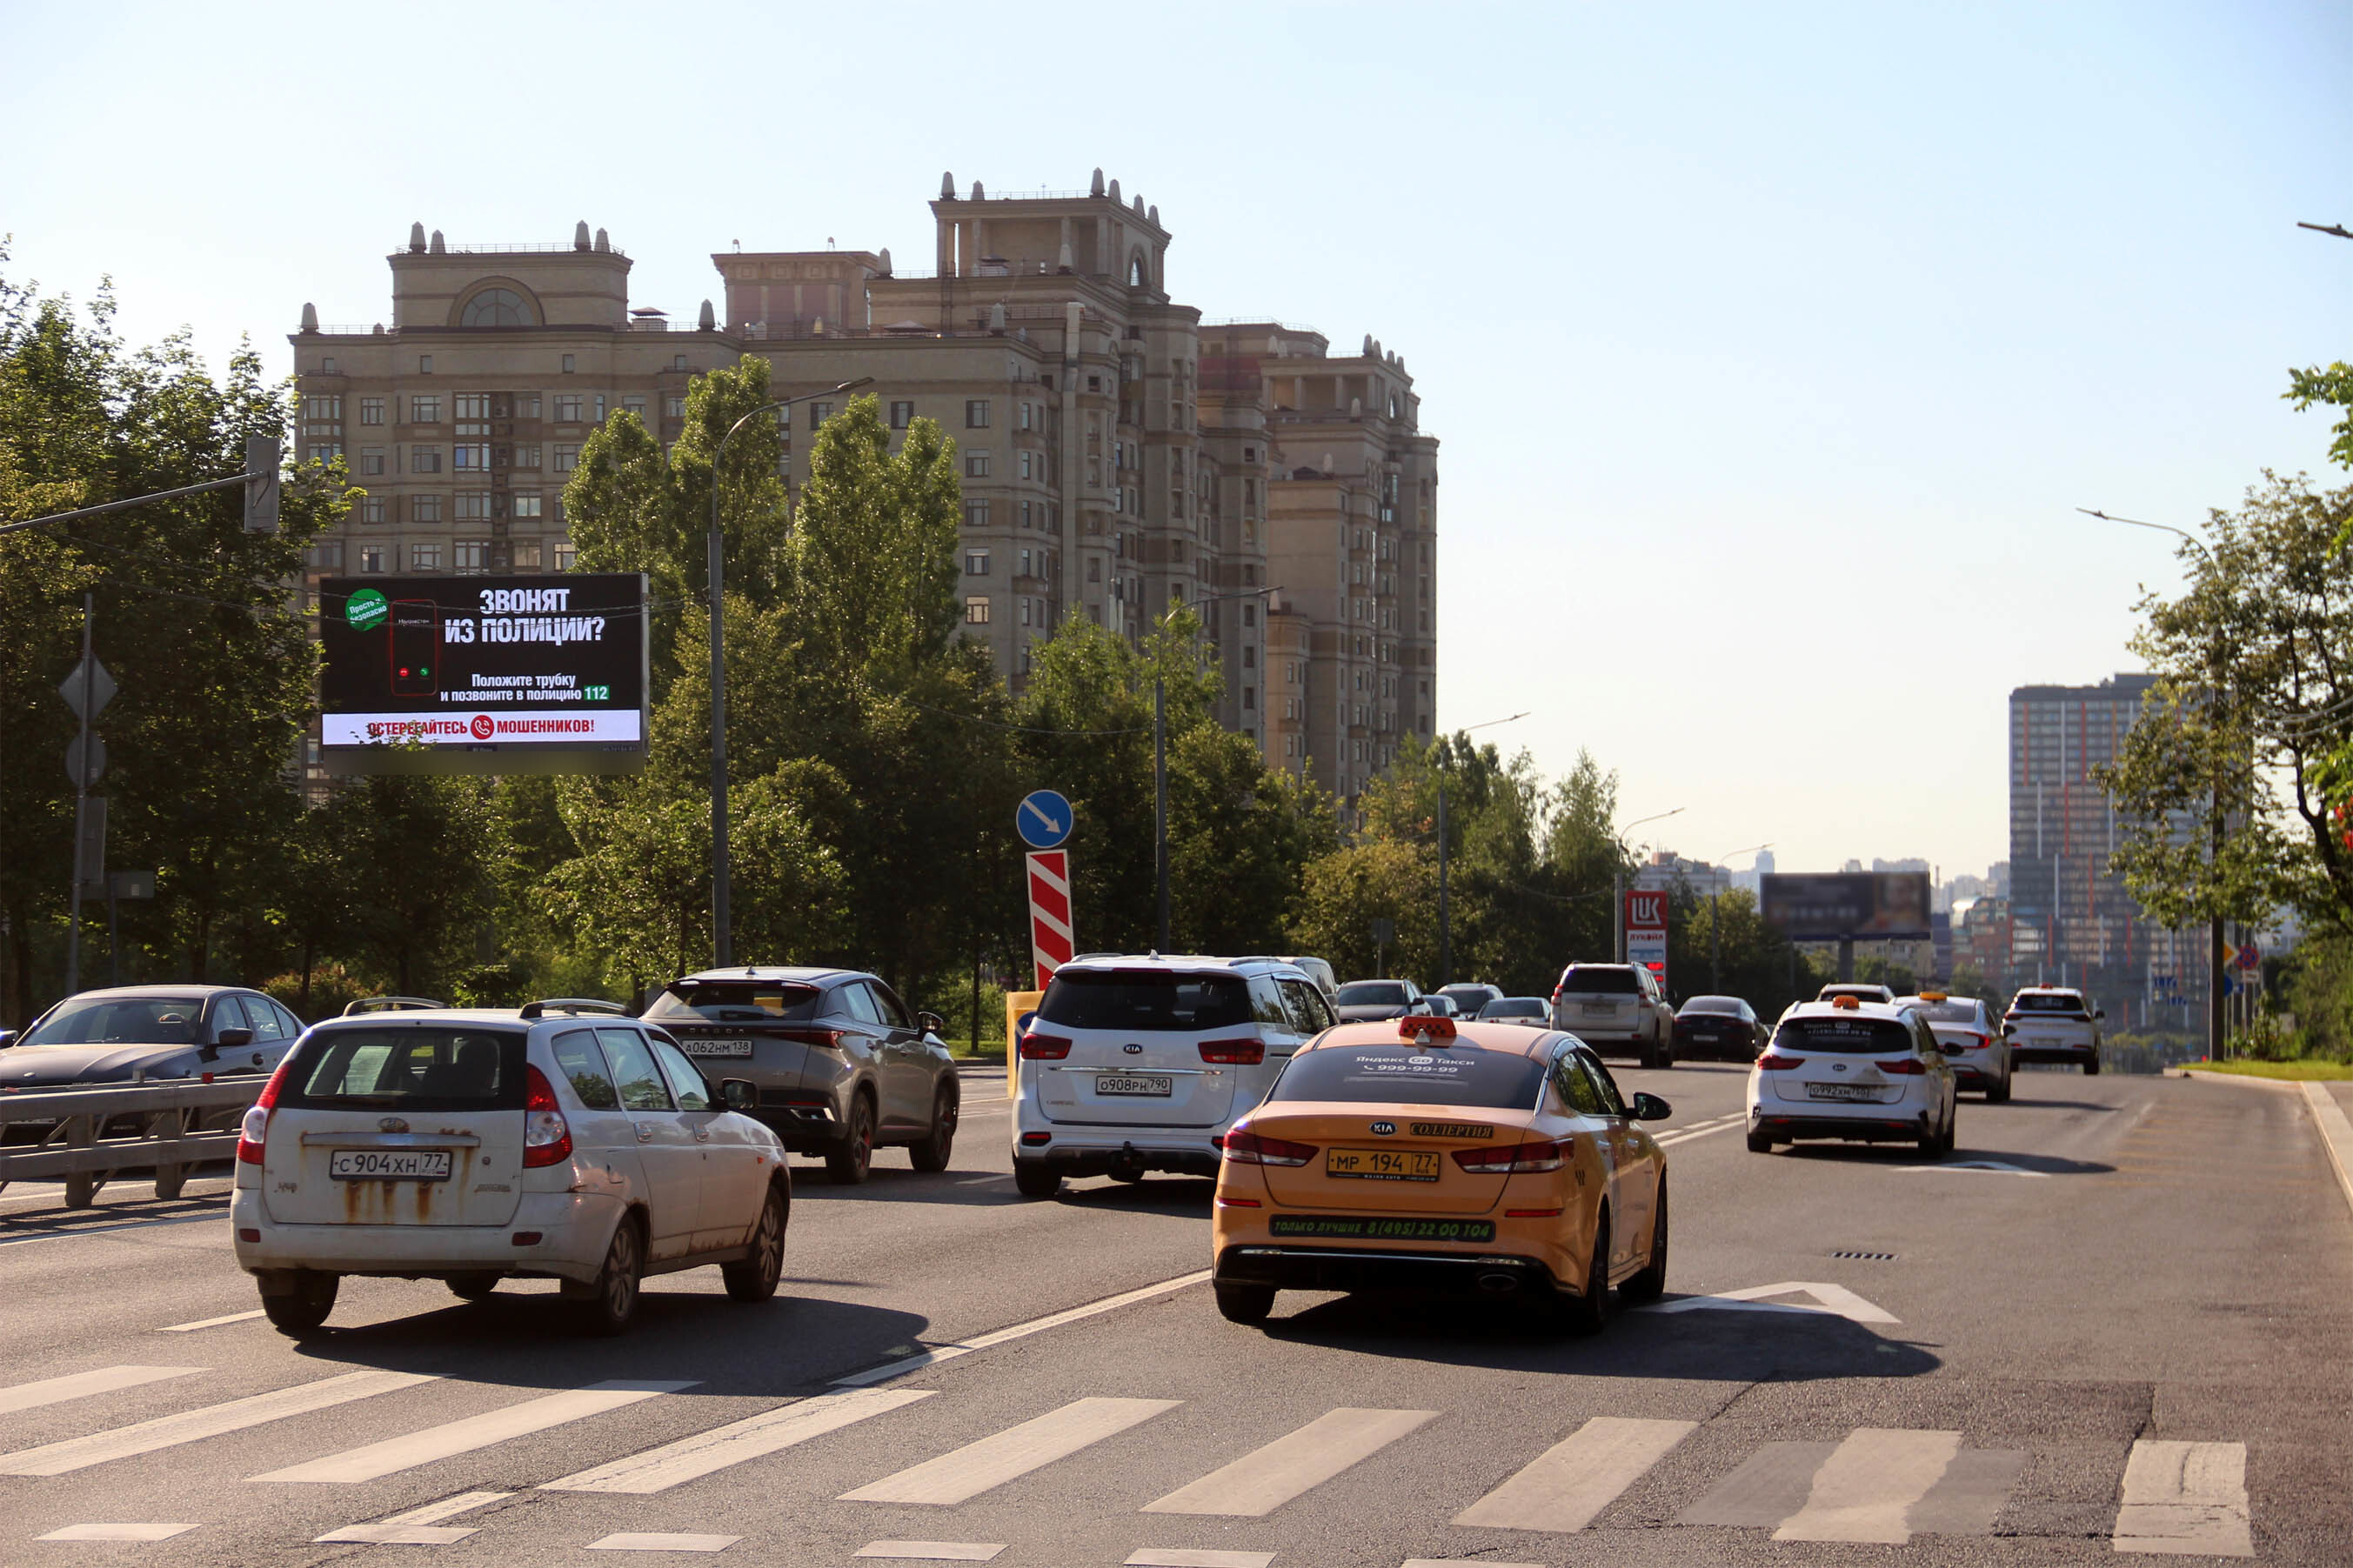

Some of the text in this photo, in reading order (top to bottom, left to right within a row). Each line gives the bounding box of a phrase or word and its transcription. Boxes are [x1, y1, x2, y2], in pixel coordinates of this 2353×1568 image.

[350, 600, 374, 614] Просто
[480, 589, 570, 614] ЗВОНЯТ
[445, 617, 605, 646] ИЗ ПОЛИЦИИ?
[471, 673, 576, 689] Положите трубку
[440, 686, 608, 702] и позвоните в полицию 112
[497, 719, 595, 733] МОШЕННИКОВ!
[1100, 1079, 1147, 1091] О908РН
[1150, 1079, 1167, 1088] 790
[1374, 1124, 1394, 1133] KIA
[424, 1153, 443, 1168] 77
[1337, 1153, 1433, 1171] МР 194 77
[1274, 1221, 1315, 1232] ТОЛЬКО
[1317, 1222, 1362, 1233] ЛУЧШИЕ
[1418, 1223, 1436, 1235] 22
[1439, 1224, 1461, 1236] 00
[1463, 1224, 1491, 1238] 104
